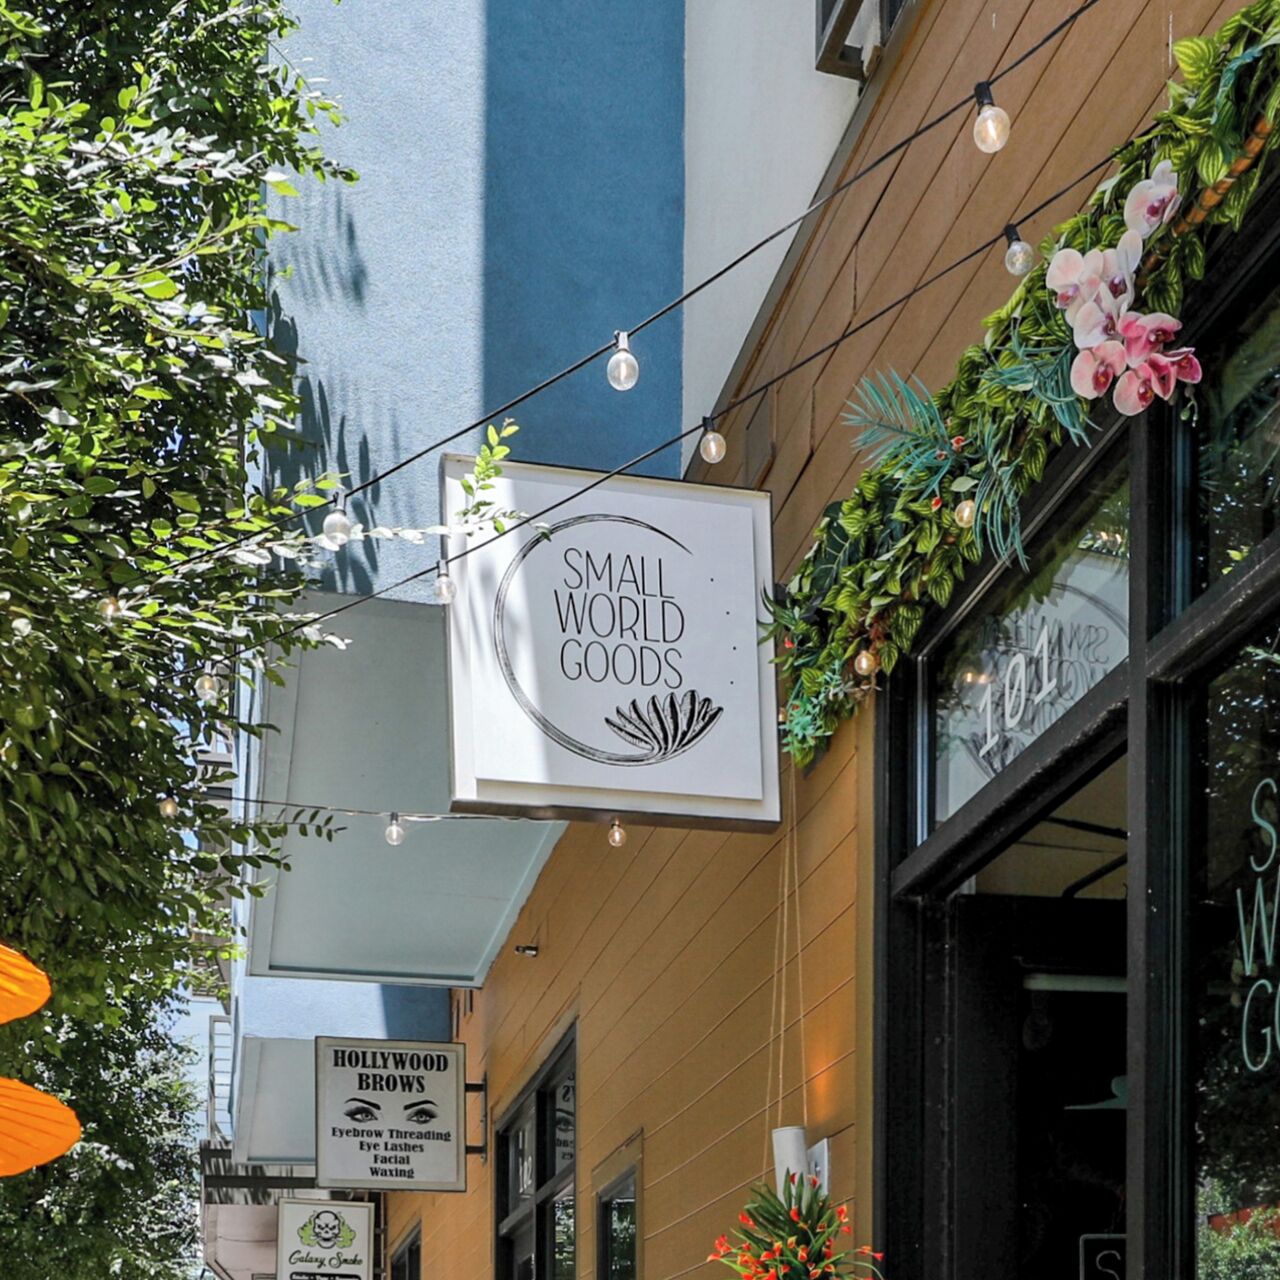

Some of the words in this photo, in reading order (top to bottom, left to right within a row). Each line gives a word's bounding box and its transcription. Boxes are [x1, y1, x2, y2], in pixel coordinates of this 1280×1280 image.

[563, 547, 676, 600] SMALL
[553, 588, 685, 644] WORLD
[560, 638, 684, 690] GOODS
[979, 624, 1057, 758] 101
[333, 1049, 449, 1072] HOLLYWOOD
[357, 1073, 426, 1093] BROWS
[331, 1127, 385, 1140] Eyebrow
[387, 1129, 452, 1142] Threading
[359, 1140, 380, 1152] Eye
[384, 1141, 424, 1153] Lashes
[373, 1154, 410, 1165] Facial
[369, 1166, 415, 1178] Waxing
[288, 1250, 326, 1269] Galaxy
[328, 1251, 363, 1269] Smoke
